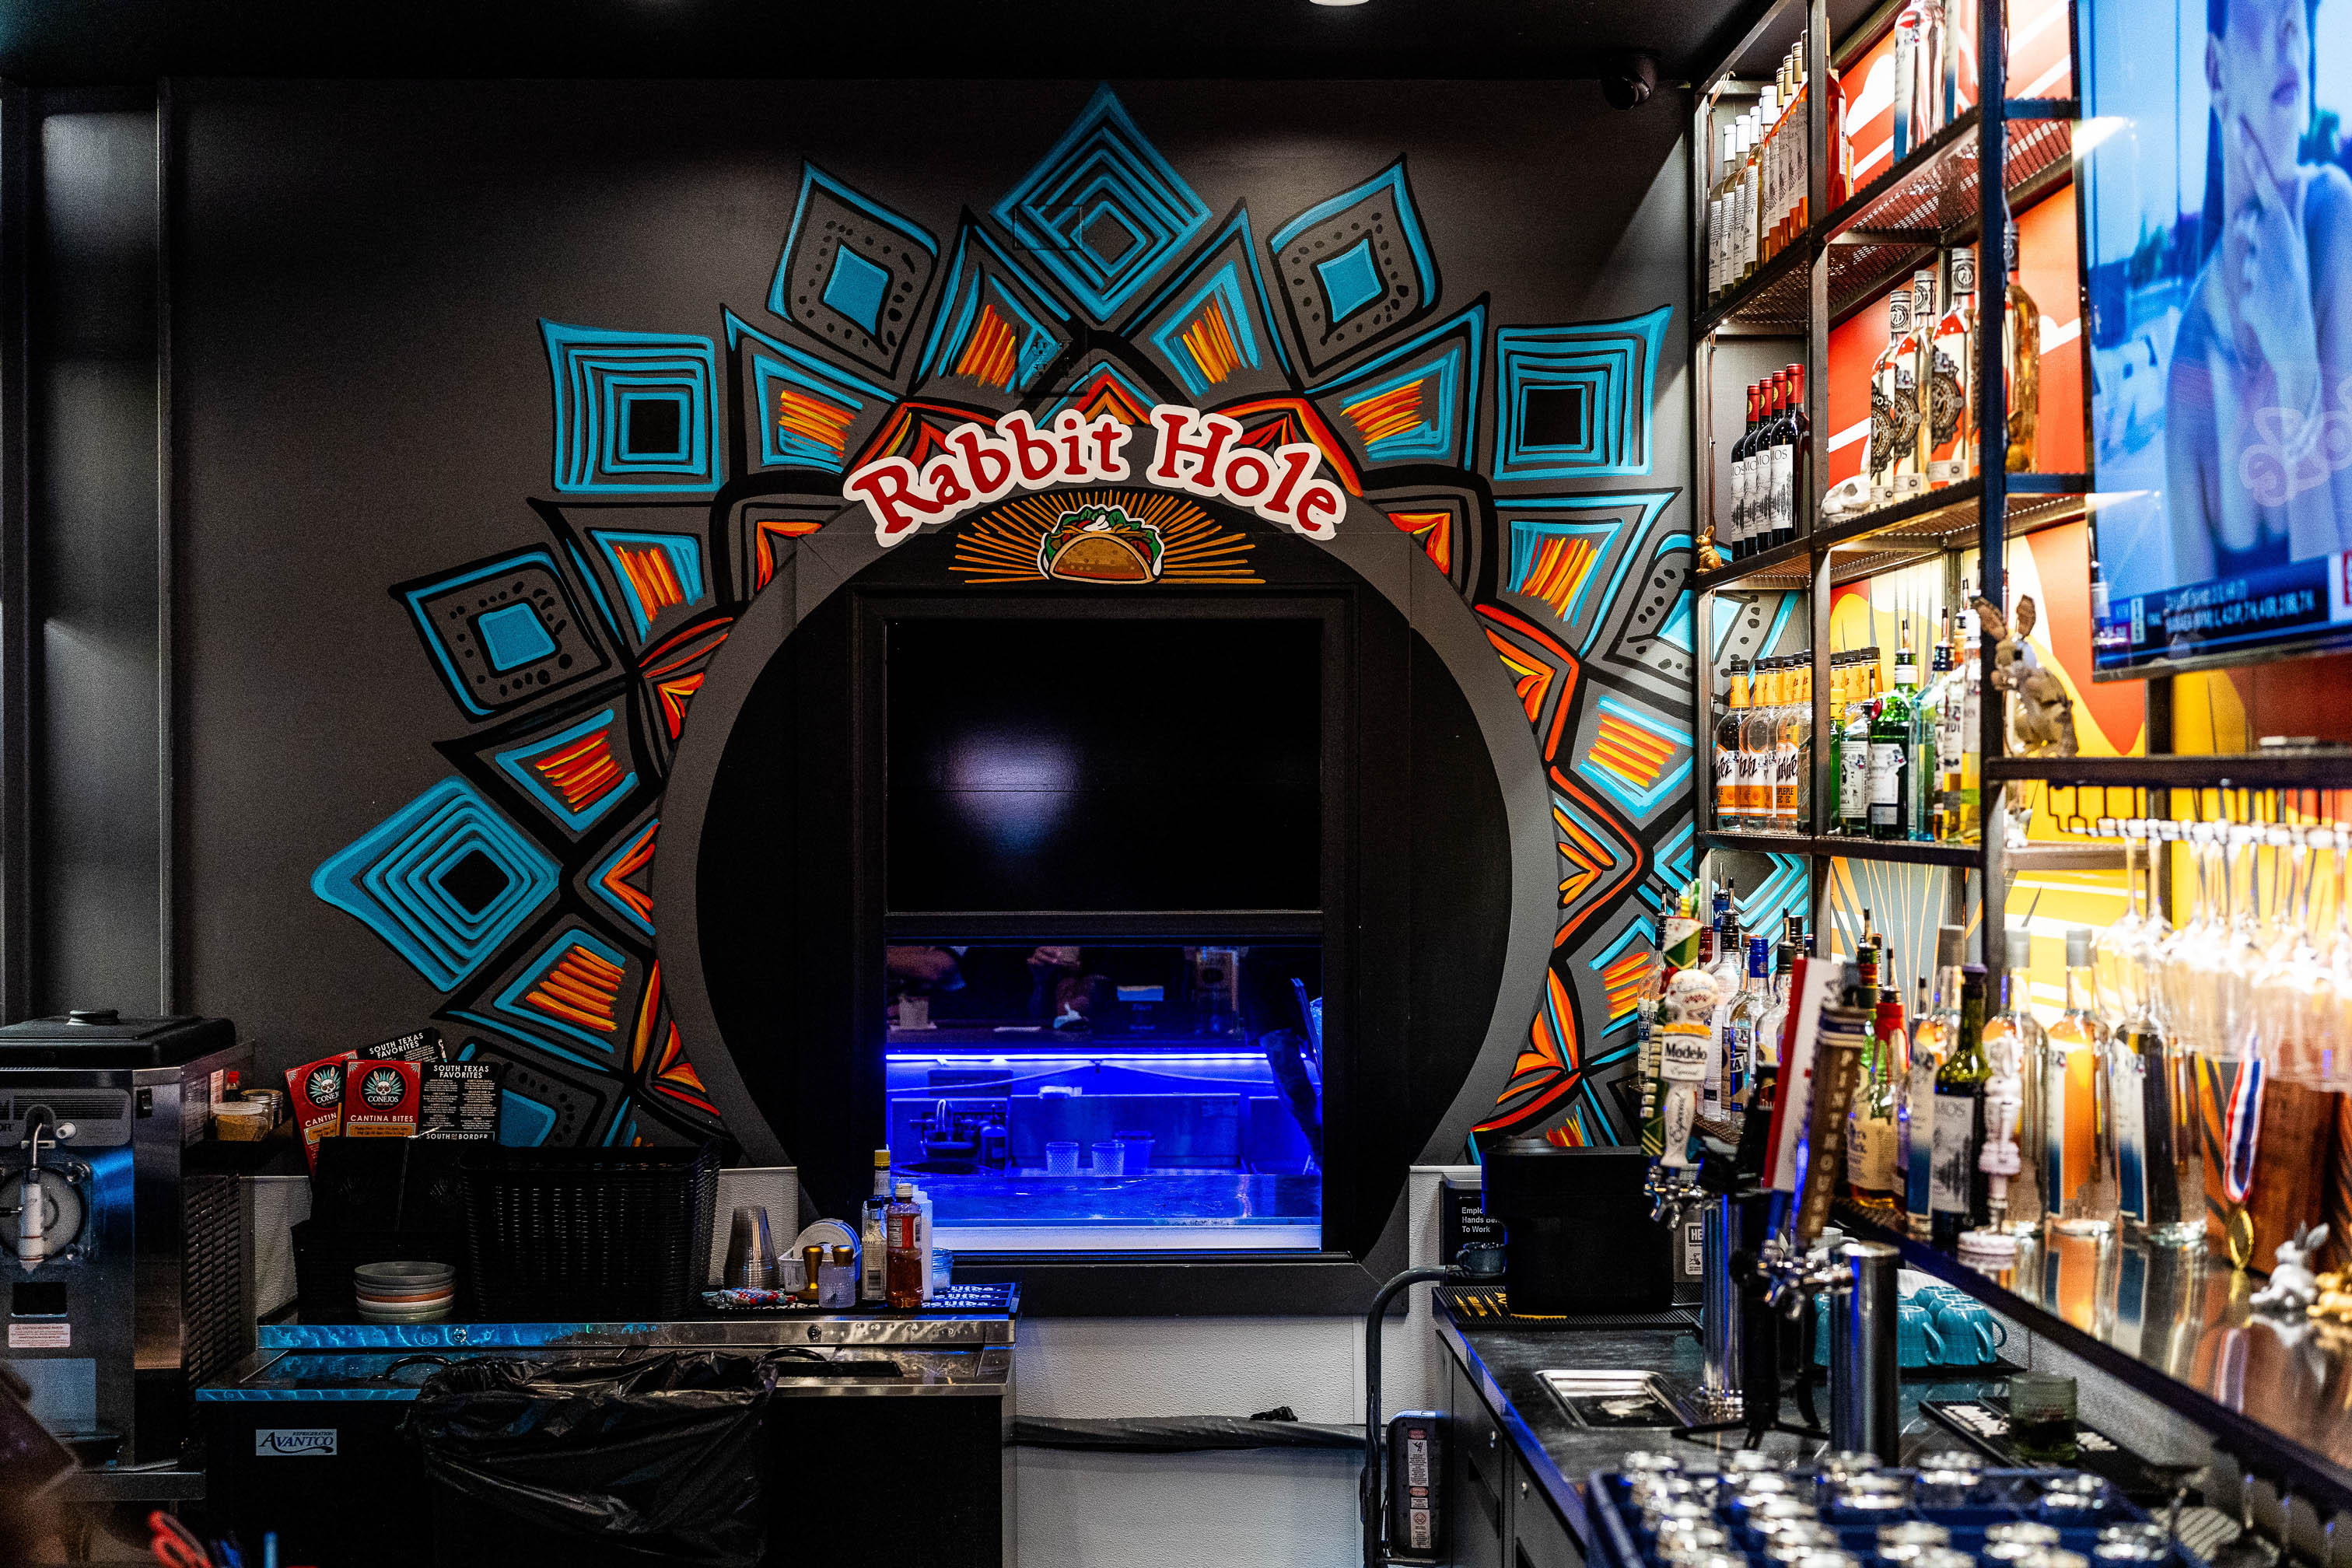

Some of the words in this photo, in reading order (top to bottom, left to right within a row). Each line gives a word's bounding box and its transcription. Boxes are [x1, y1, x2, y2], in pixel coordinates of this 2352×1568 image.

[850, 415, 1124, 537] Rabbit
[1157, 411, 1339, 534] Hole
[369, 1041, 396, 1055] SOUTH
[398, 1032, 424, 1045] TEXAS
[377, 1041, 419, 1059] FAVORITES
[1664, 1042, 1707, 1059] Modelo
[316, 1091, 340, 1104] CONEJ
[305, 1112, 337, 1127] CANTIN
